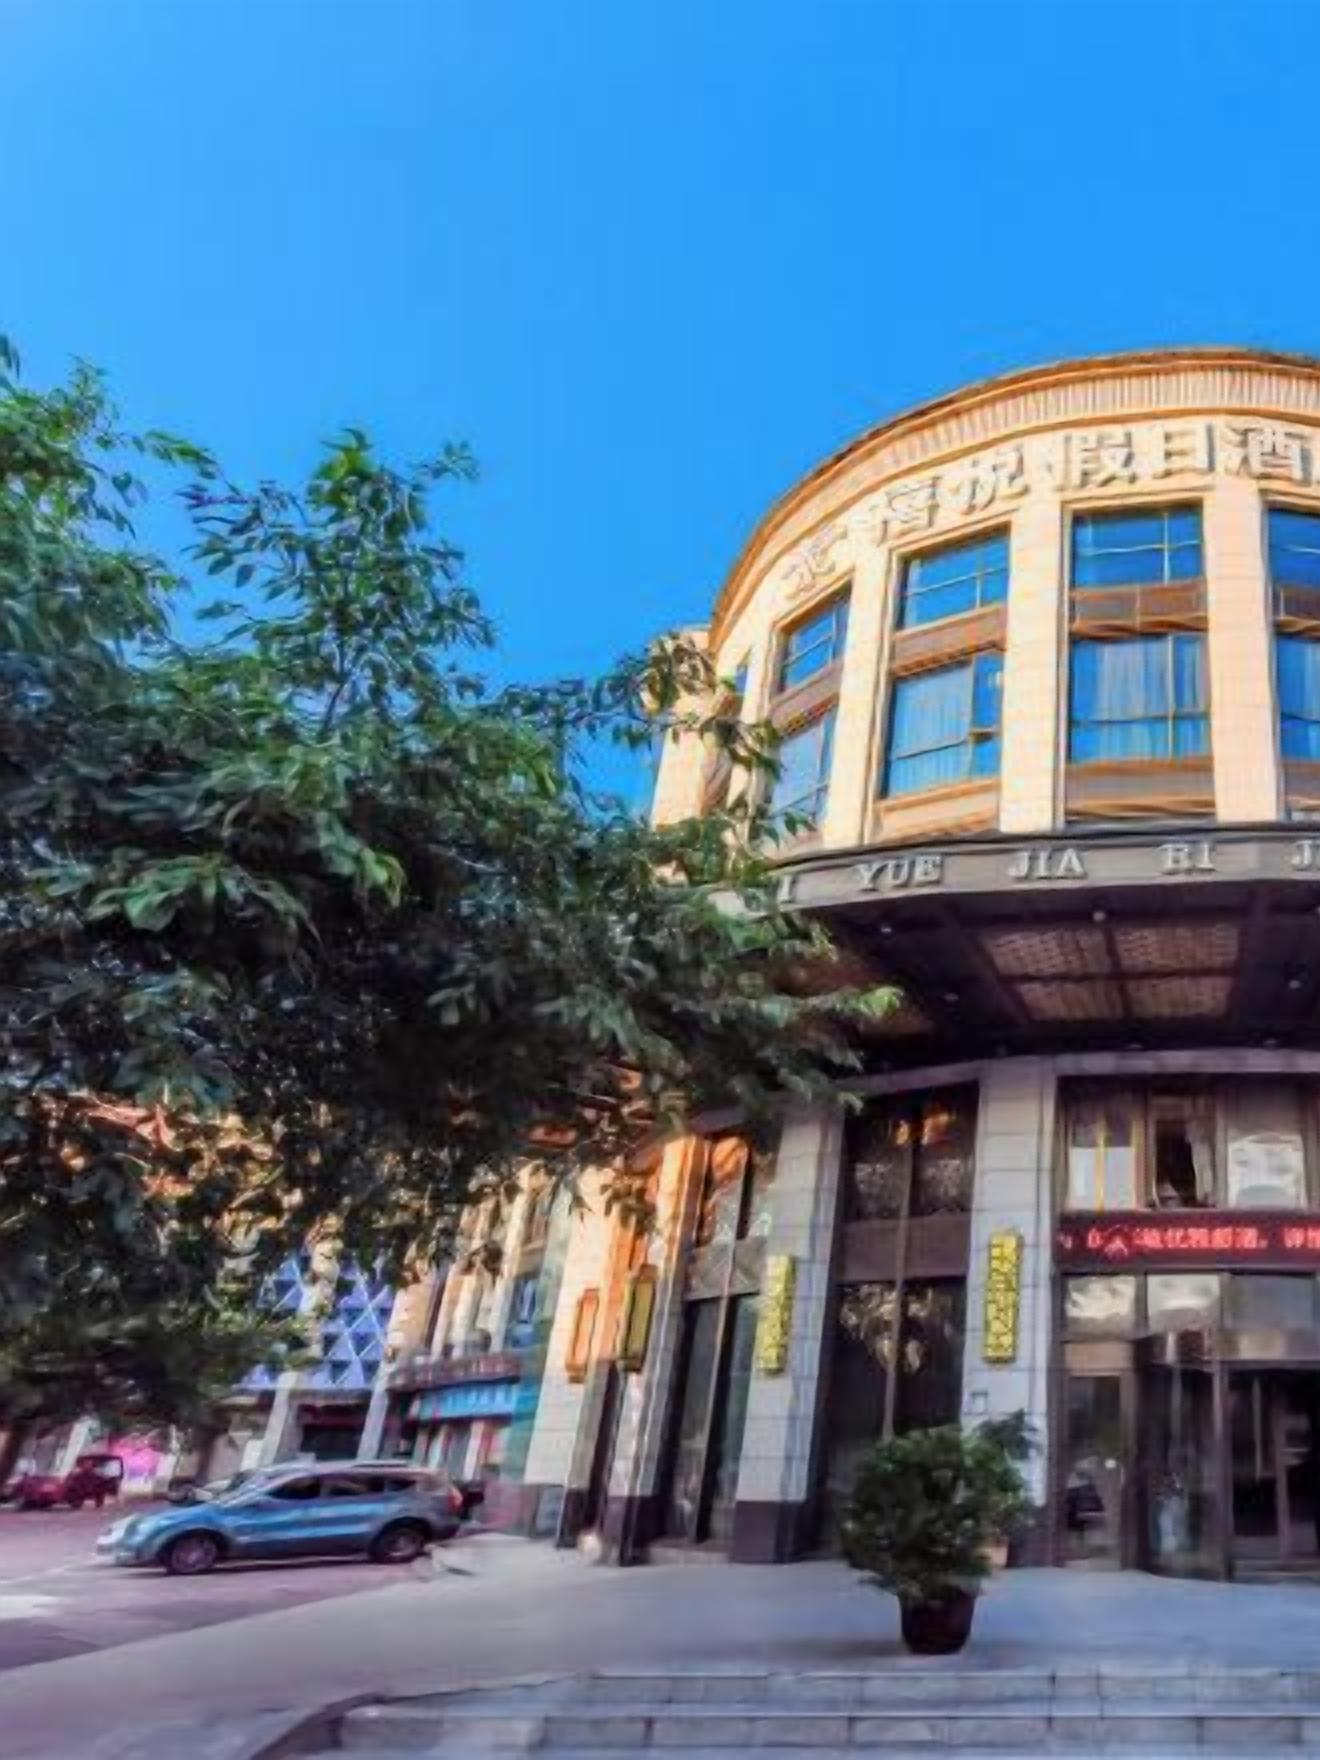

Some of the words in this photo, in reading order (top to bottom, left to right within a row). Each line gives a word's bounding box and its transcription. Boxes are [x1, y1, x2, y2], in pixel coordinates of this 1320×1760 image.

[856, 855, 942, 890] YUE
[1008, 848, 1088, 879] JIA
[1157, 842, 1215, 873] RI
